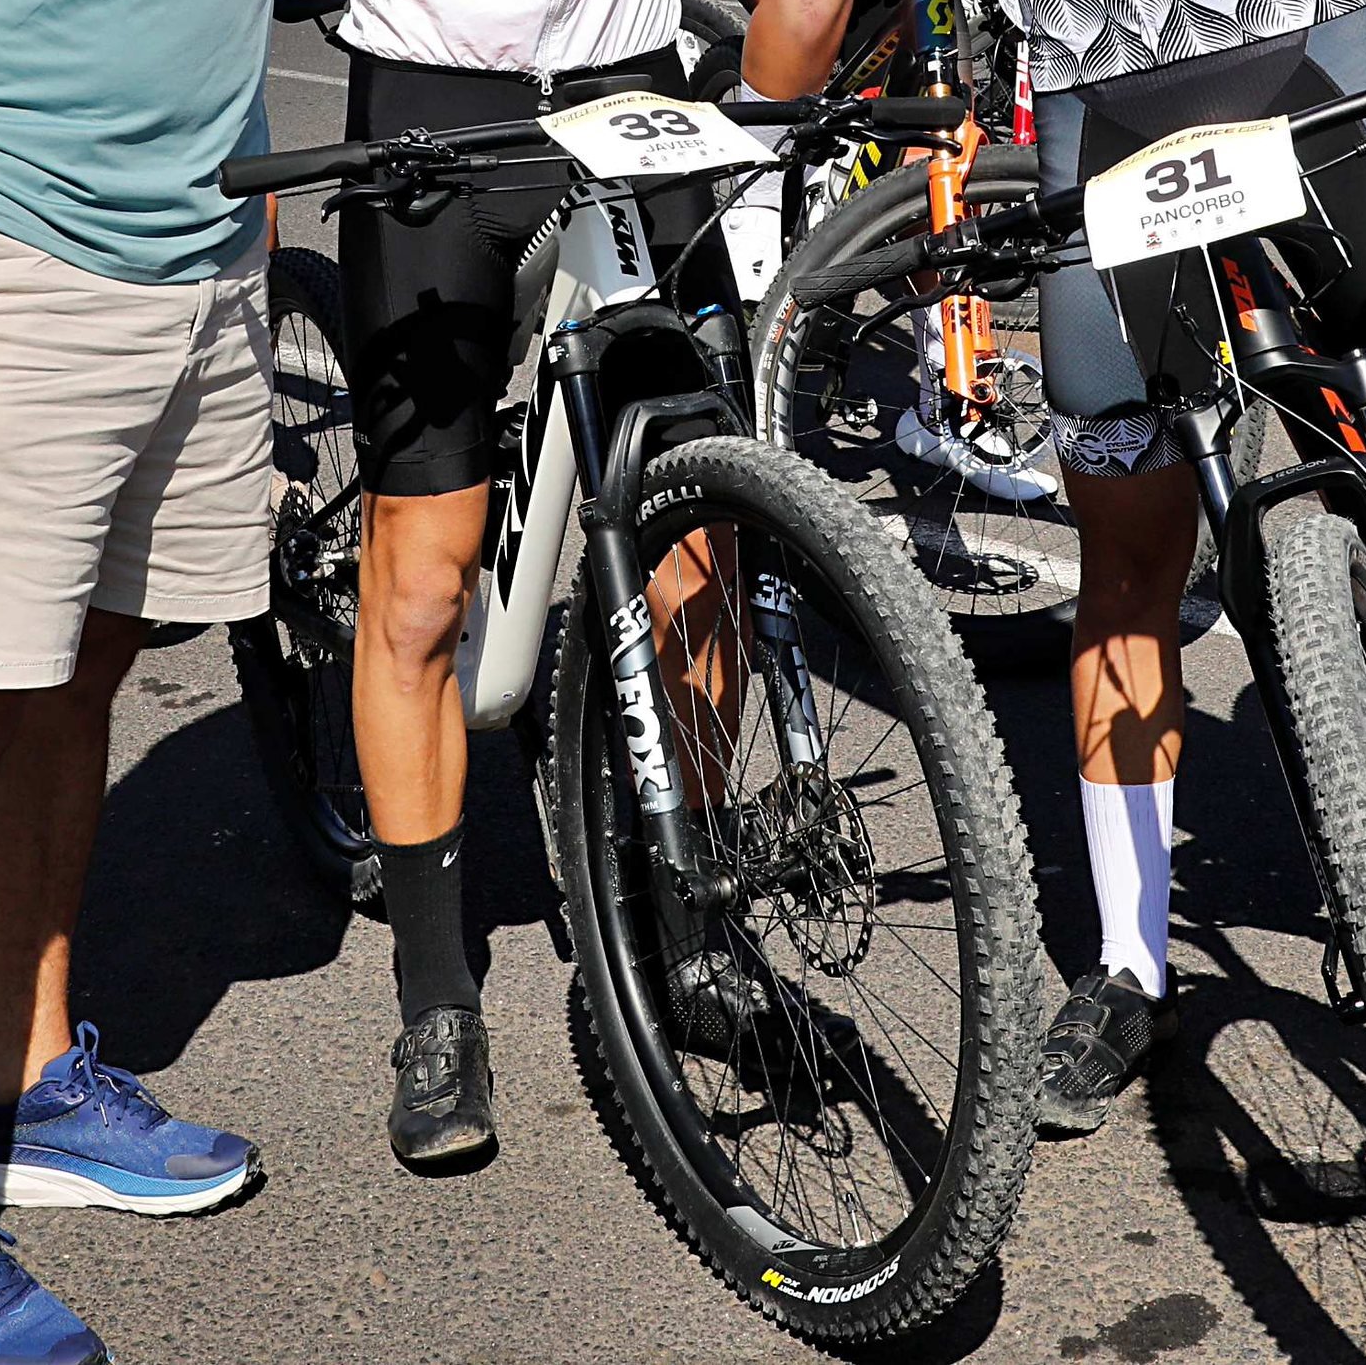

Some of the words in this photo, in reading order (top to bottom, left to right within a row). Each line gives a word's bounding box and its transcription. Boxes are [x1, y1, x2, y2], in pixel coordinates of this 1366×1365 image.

[609, 109, 701, 140] 33
[1150, 135, 1187, 154] BIKE
[1190, 127, 1235, 142] RACE
[645, 139, 708, 154] JAVIER
[1145, 148, 1232, 203] 31
[1140, 190, 1245, 230] PANCORBO
[1275, 458, 1327, 480] RECON
[637, 484, 703, 527] IRELLI
[610, 592, 651, 641] 32
[616, 670, 671, 795] FOX
[806, 1255, 901, 1304] SCORPION
